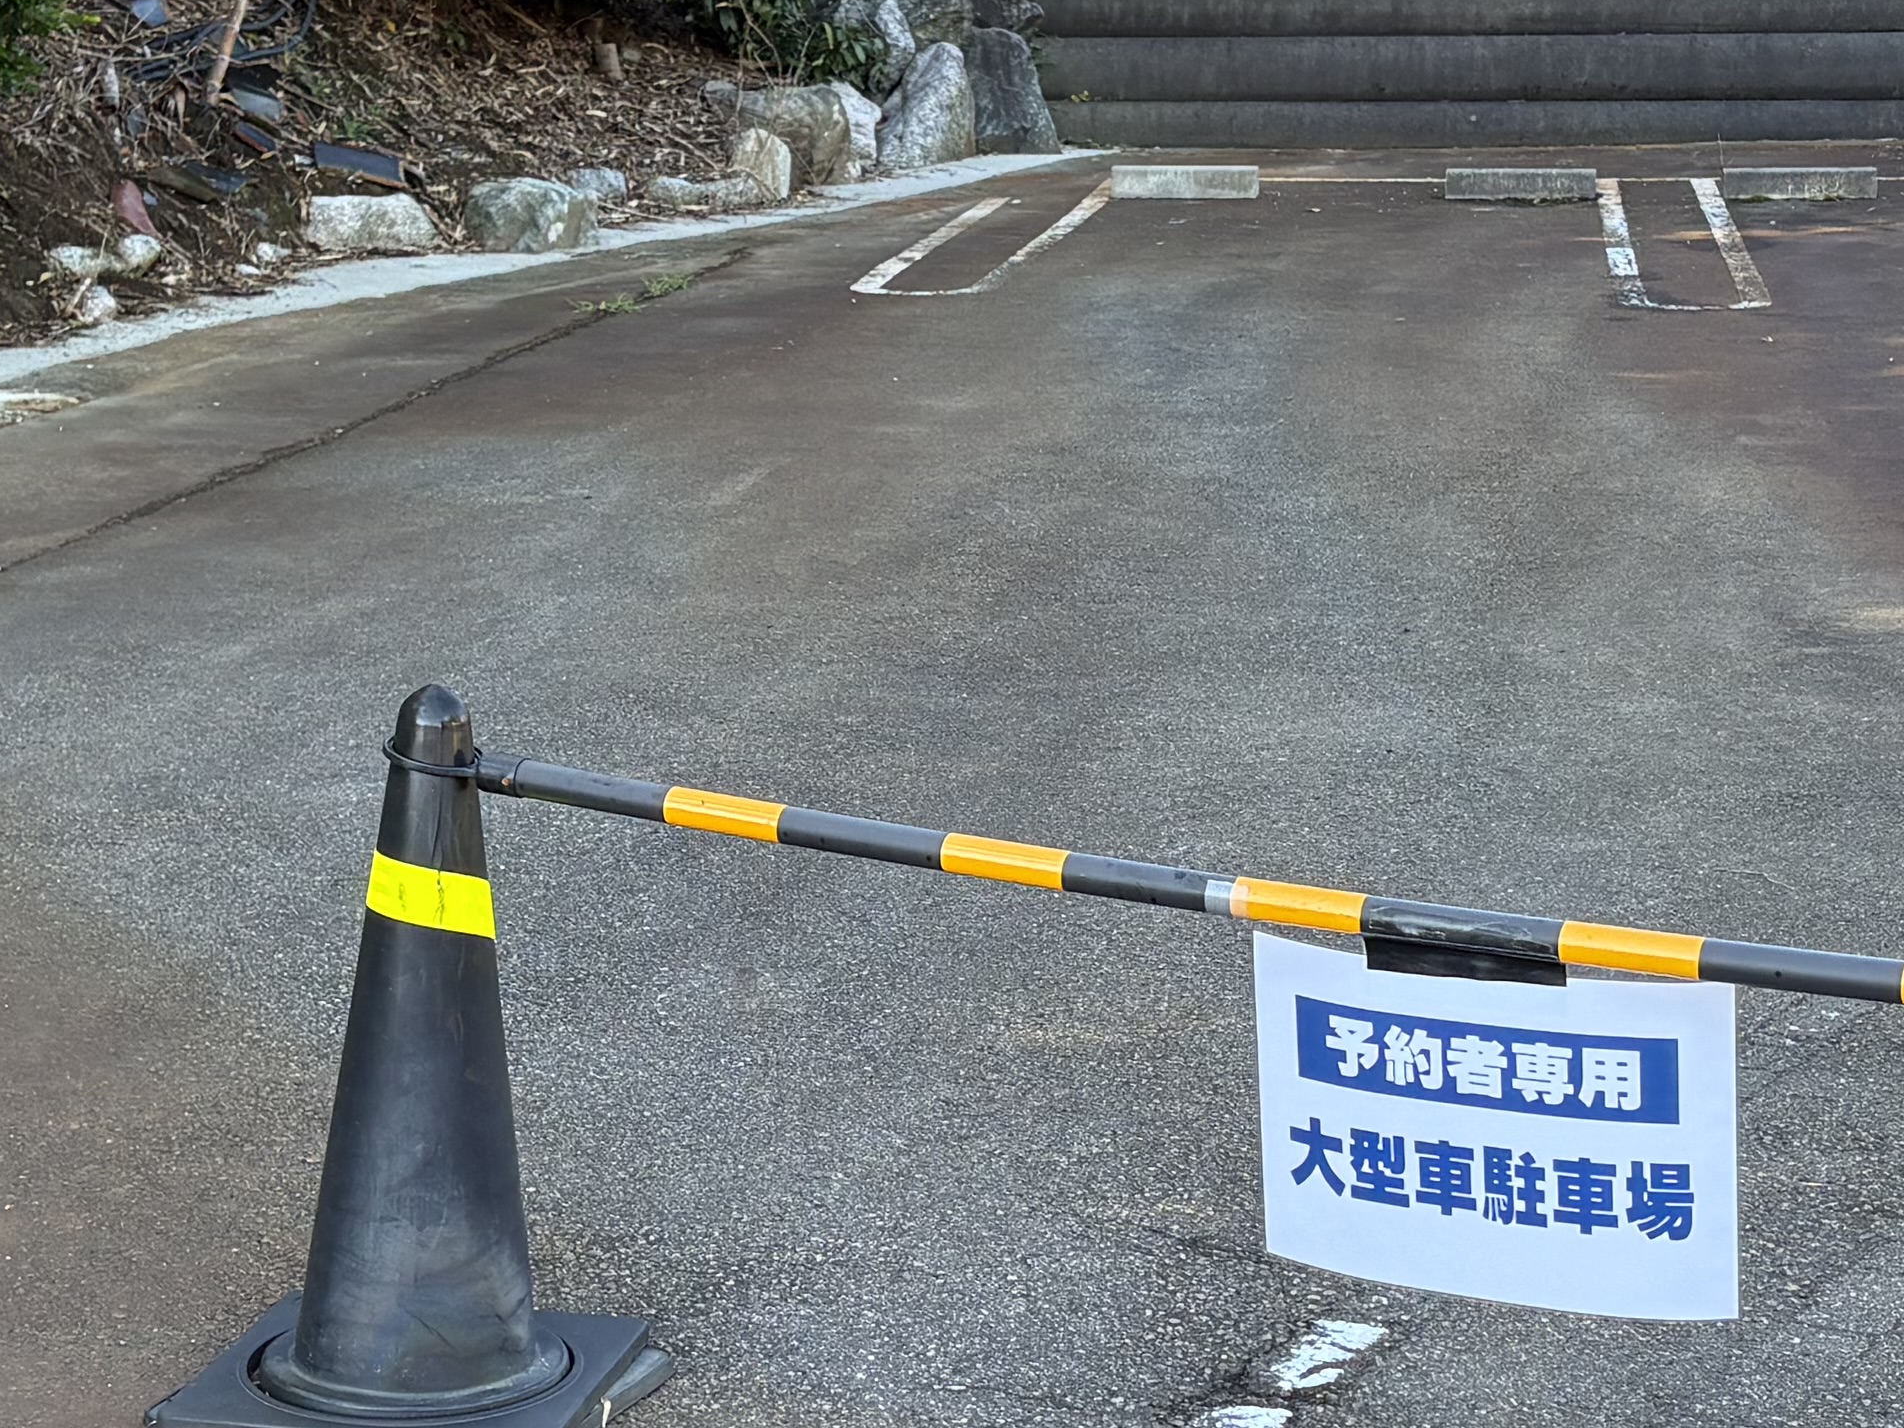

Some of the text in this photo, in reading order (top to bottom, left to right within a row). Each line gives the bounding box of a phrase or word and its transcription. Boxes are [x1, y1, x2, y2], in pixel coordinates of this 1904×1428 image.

[1325, 1015, 1642, 1110] 予約者専用
[1289, 1117, 1695, 1241] 大型車駐車場
